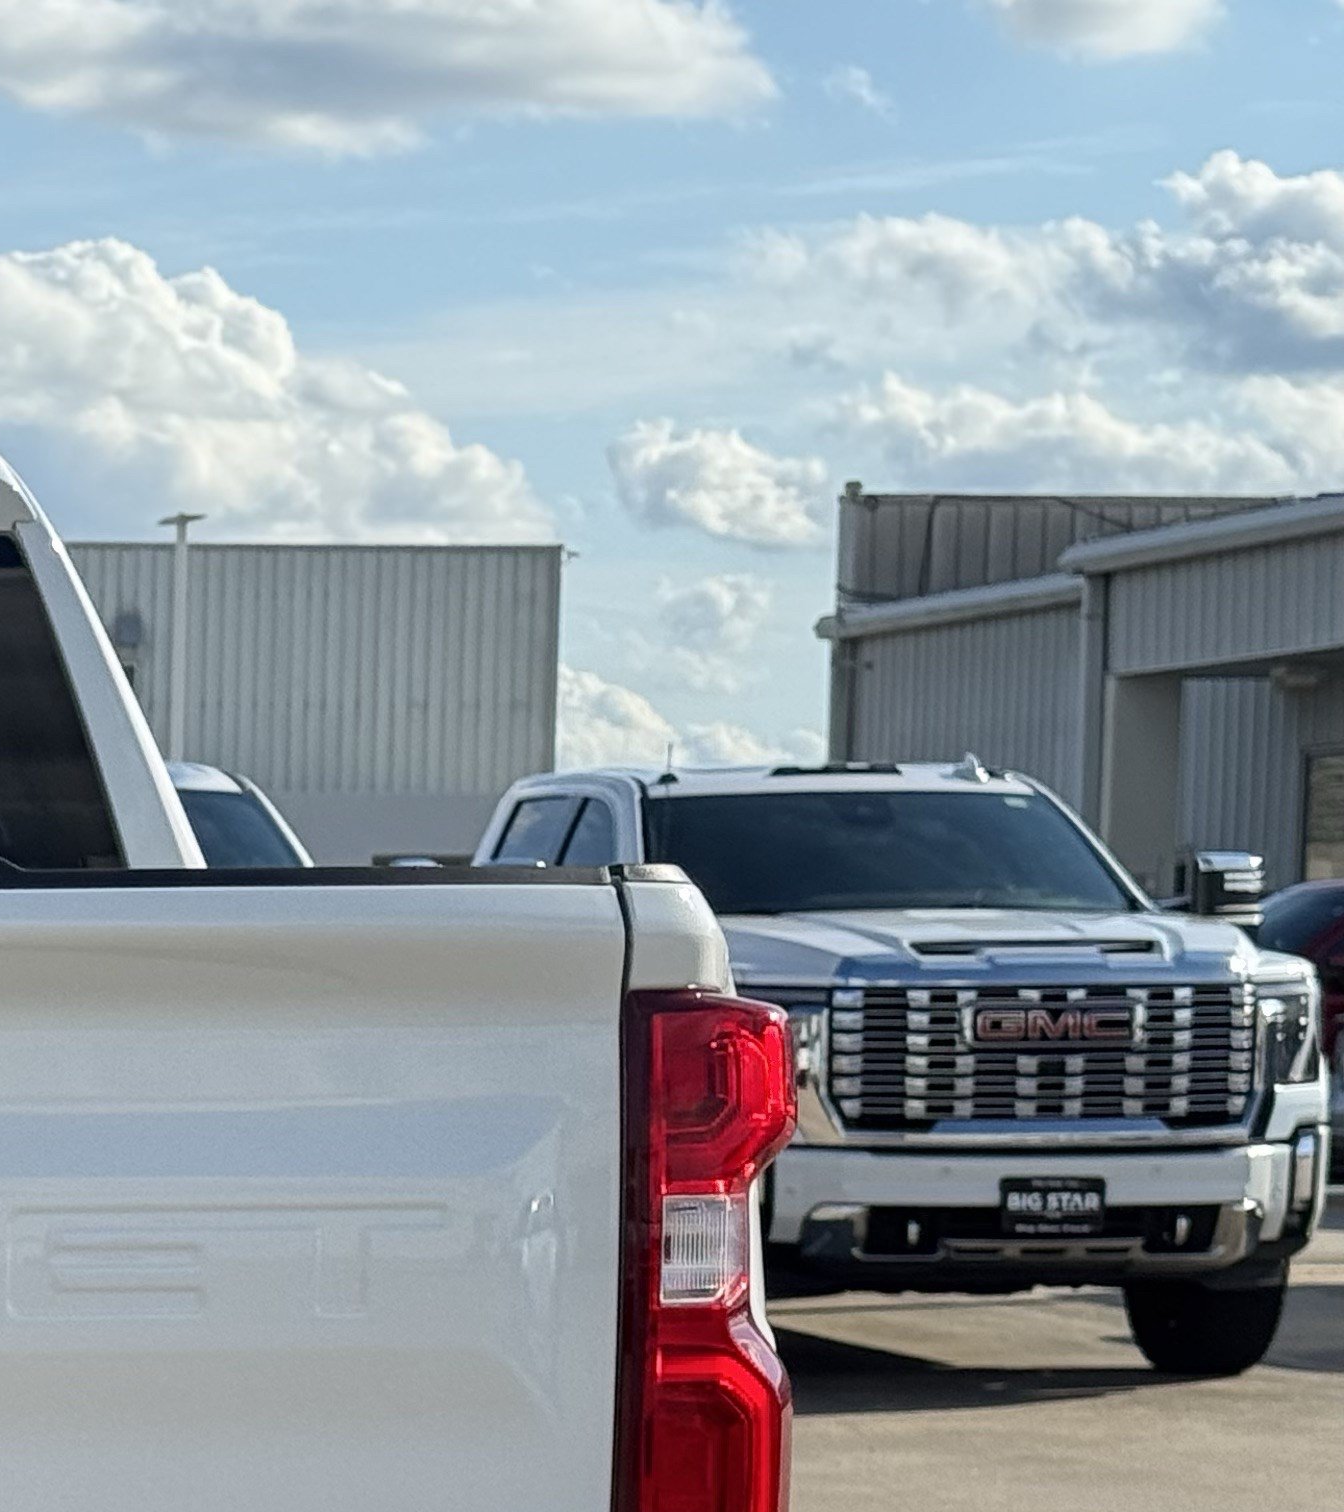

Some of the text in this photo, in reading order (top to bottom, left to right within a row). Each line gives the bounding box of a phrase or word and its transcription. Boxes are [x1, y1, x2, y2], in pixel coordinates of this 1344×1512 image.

[976, 1009, 1130, 1041] GMC
[1007, 1191, 1100, 1212] BIG STAR
